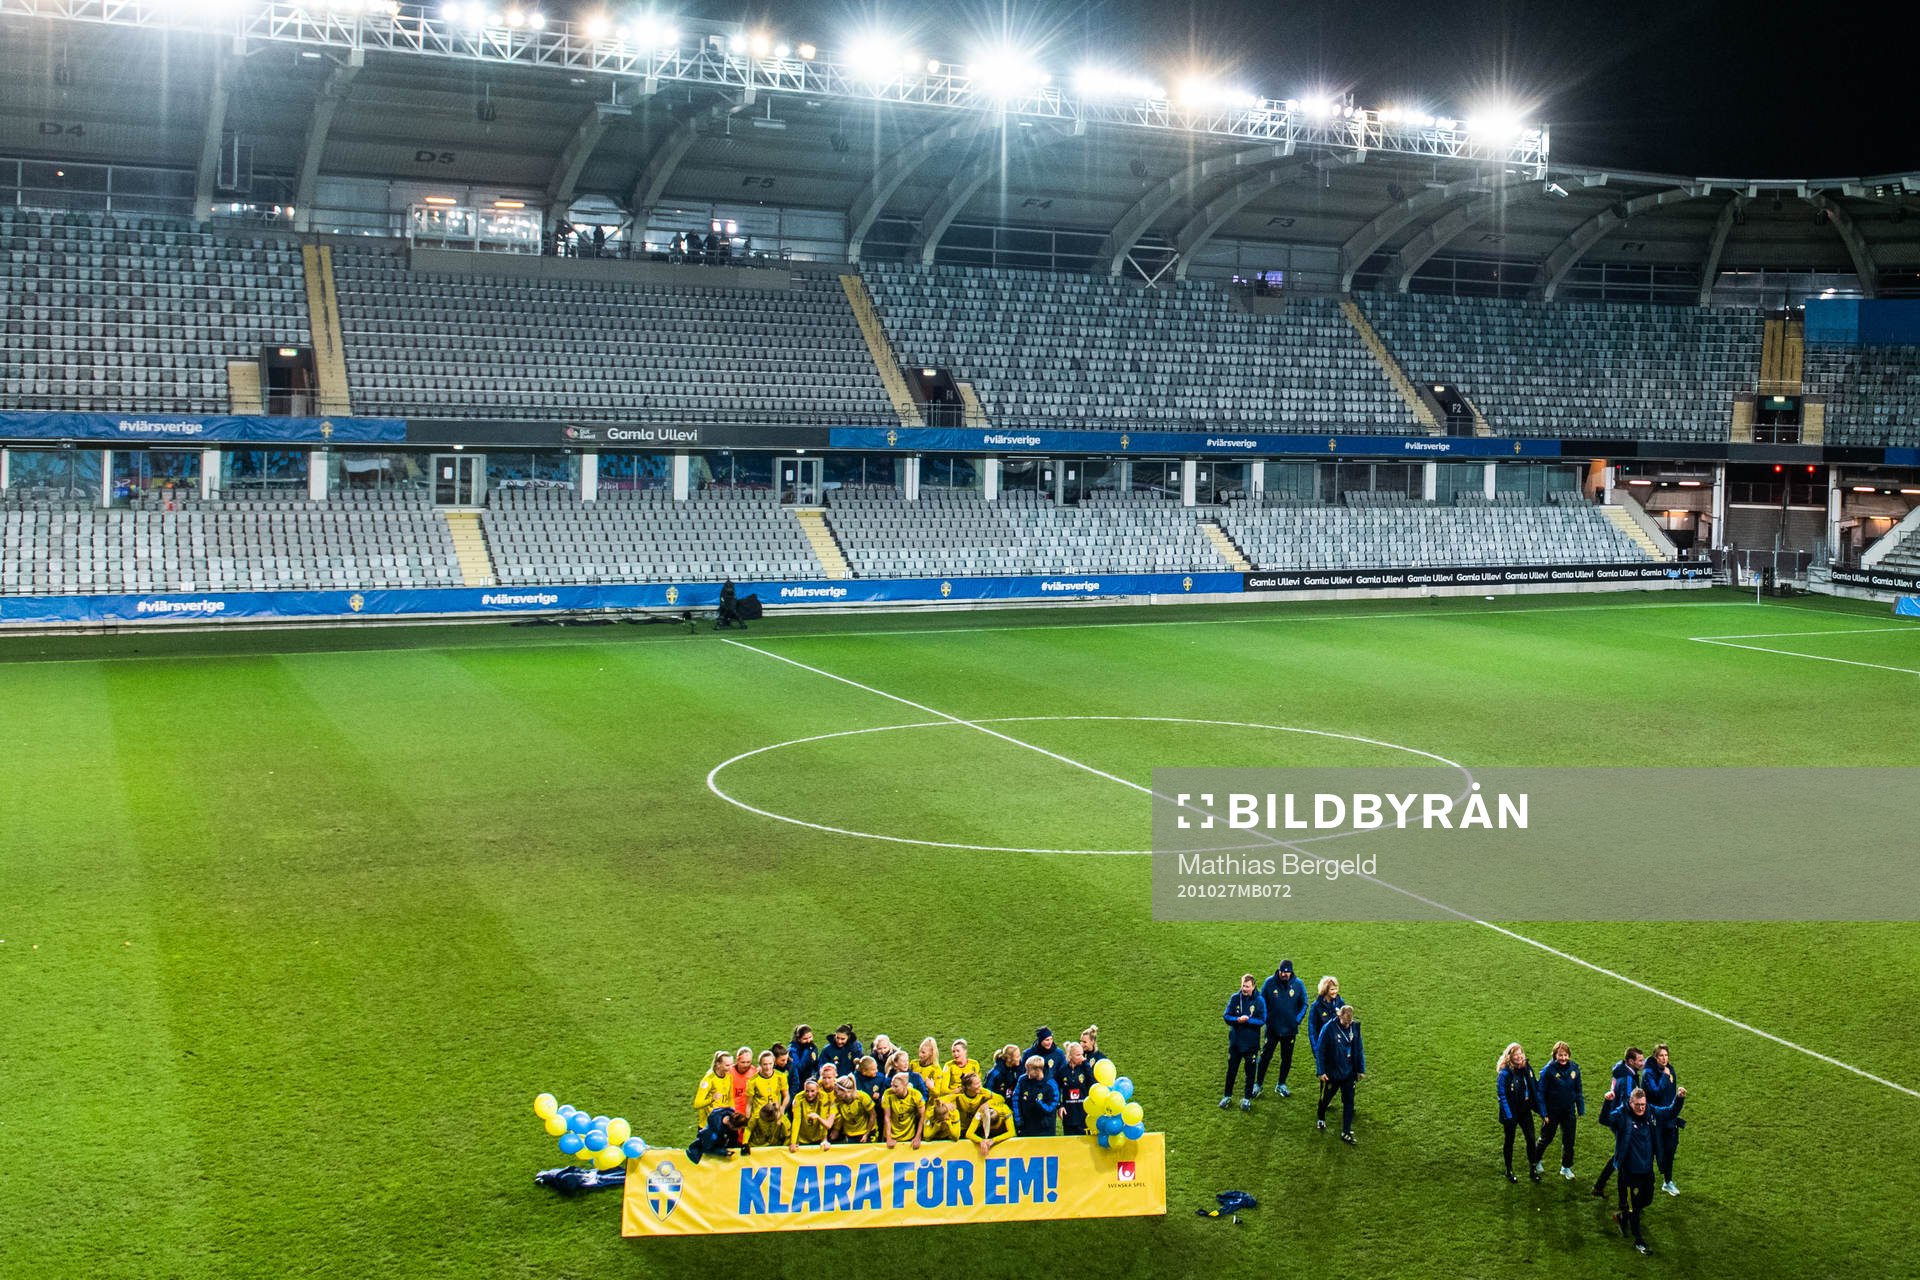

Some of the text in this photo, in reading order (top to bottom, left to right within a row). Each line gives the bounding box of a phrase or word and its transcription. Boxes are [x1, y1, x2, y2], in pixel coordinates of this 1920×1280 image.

[39, 121, 86, 137] D4
[415, 150, 455, 164] D5
[742, 175, 775, 189] F5
[1266, 216, 1296, 228] F3
[1452, 403, 1462, 413] F2
[119, 421, 203, 434] #viärsverige
[607, 428, 698, 440] Gamla Ullevi
[984, 434, 1041, 446] #viärsverige
[1206, 438, 1257, 449] #viärsverige
[1249, 578, 1276, 587] Gamla
[1303, 576, 1330, 586] Gamla
[1356, 575, 1381, 585] Gamla
[1407, 574, 1432, 583] Gamla
[1456, 573, 1480, 582] Gamla
[1505, 572, 1527, 580] Gamla
[1551, 570, 1574, 579] Gamla
[1597, 569, 1618, 578] Gamla
[1641, 569, 1662, 577] Gamla
[1832, 571, 1852, 582] Gamla
[1871, 576, 1893, 586] Gamla
[481, 592, 558, 605] #viärsverige
[780, 586, 847, 598] #viärsverige
[137, 600, 225, 613] #viärsverige
[735, 1088, 744, 1097] 12
[738, 1156, 1059, 1215] KLARA FÖR EM!
